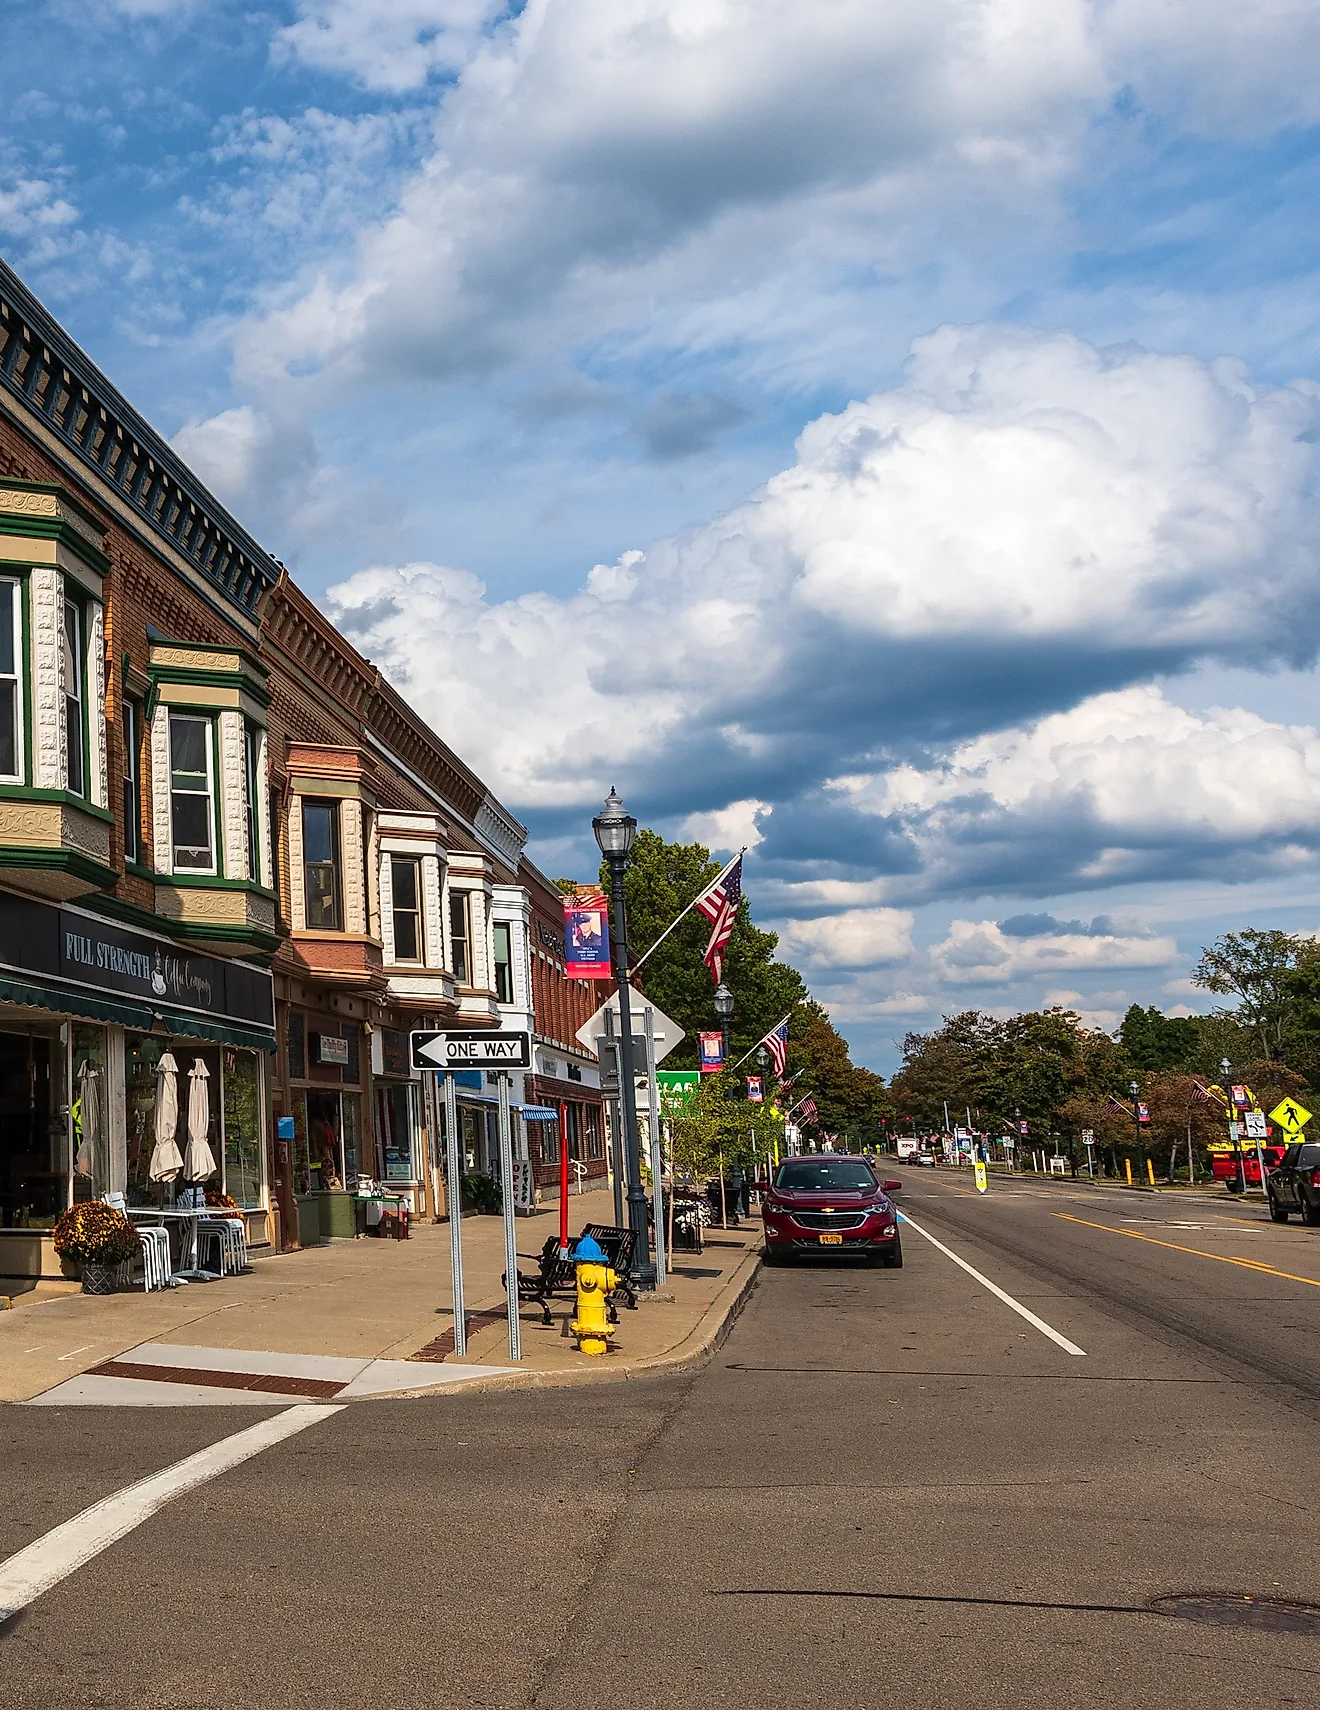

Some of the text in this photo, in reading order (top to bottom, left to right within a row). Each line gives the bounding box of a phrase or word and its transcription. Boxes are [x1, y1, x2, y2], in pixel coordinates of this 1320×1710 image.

[65, 932, 93, 966] FULL
[96, 941, 151, 980] STRENGTH
[446, 1042, 517, 1057] ONE WAY
